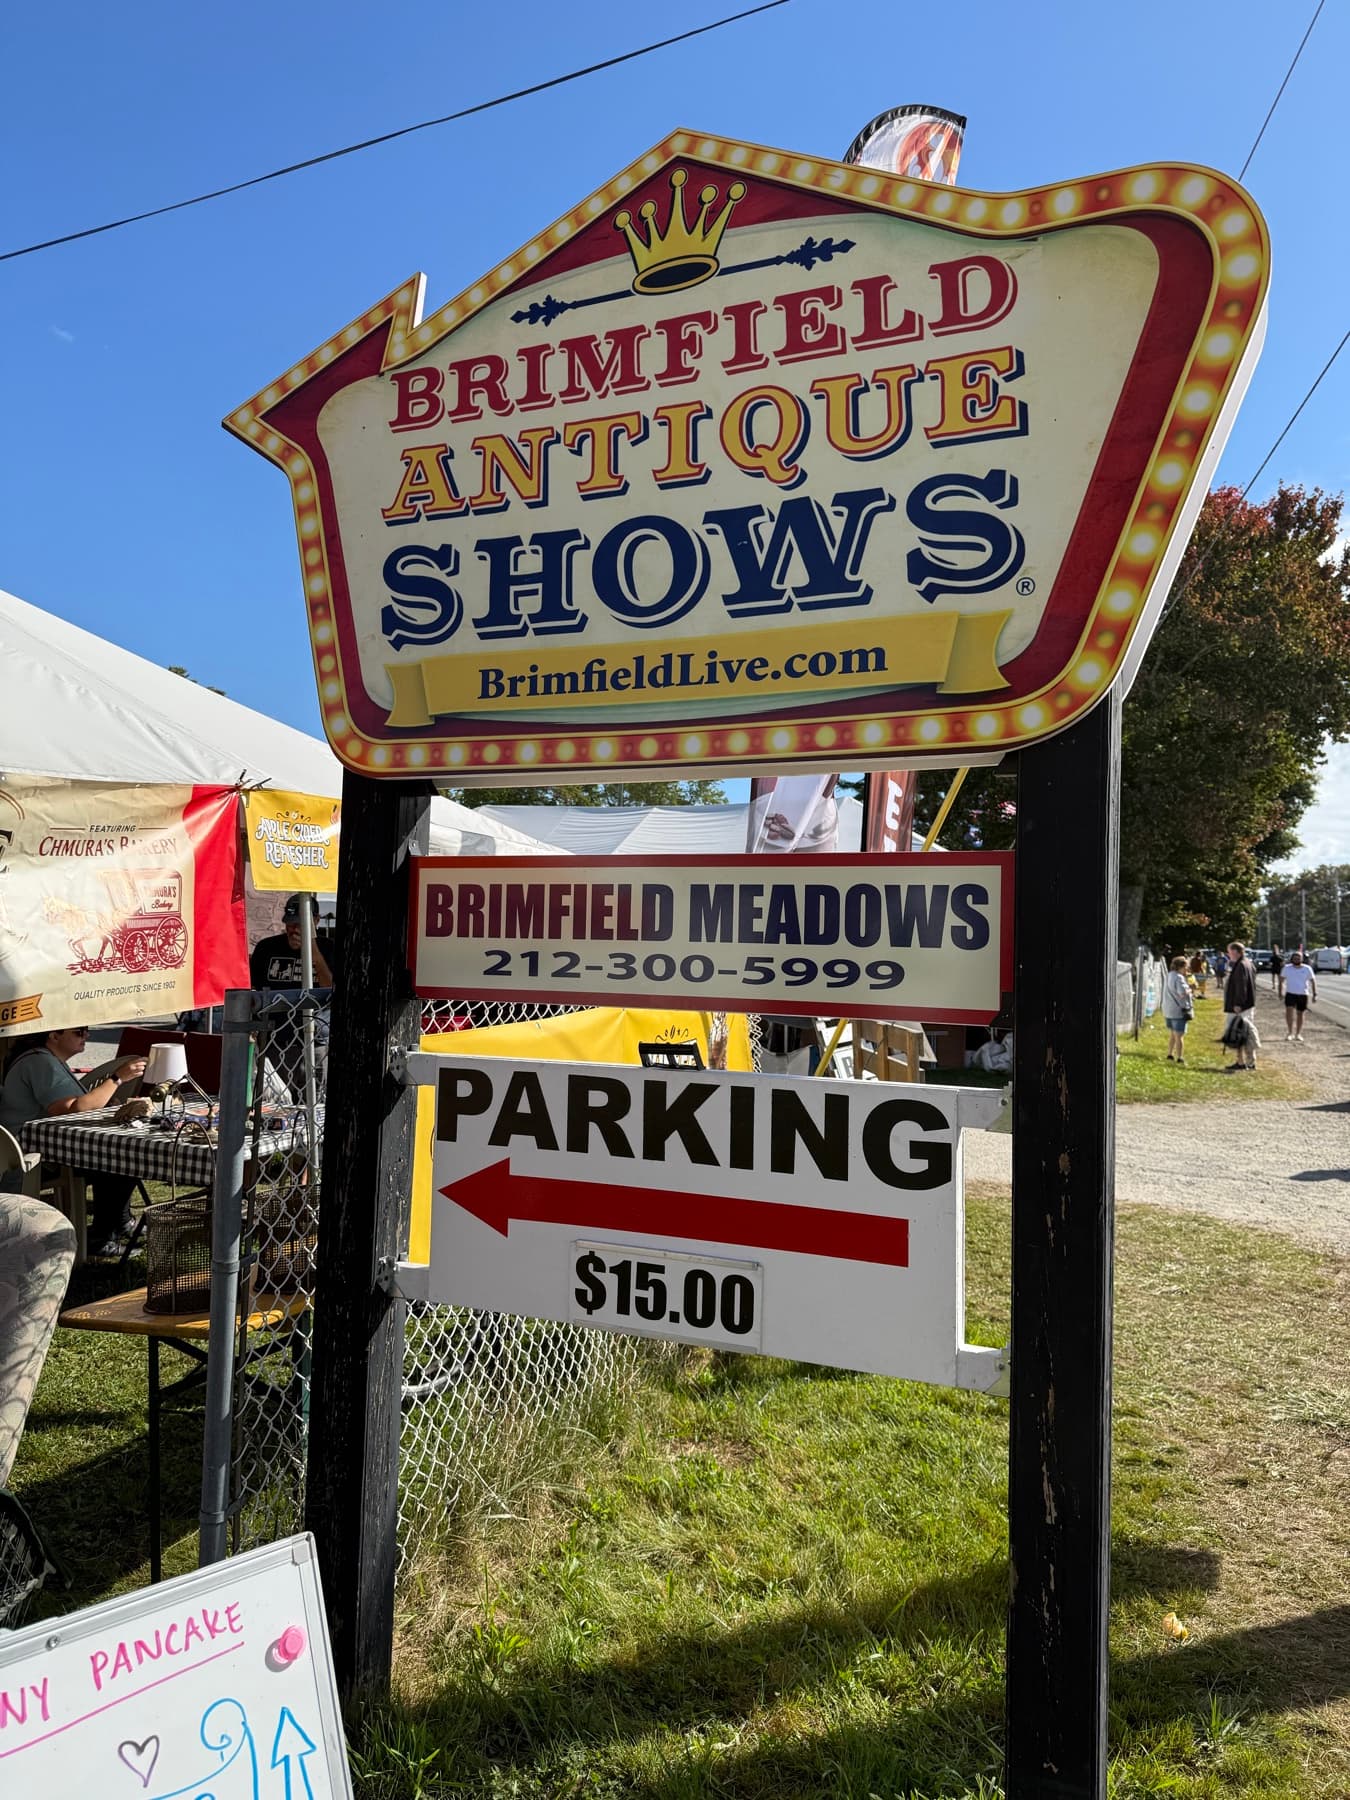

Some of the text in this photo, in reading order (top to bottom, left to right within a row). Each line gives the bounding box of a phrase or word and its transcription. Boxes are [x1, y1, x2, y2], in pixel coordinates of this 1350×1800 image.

[388, 254, 1018, 432] BRIMFIELD
[381, 345, 1028, 526] ANTIQUE
[381, 469, 1024, 651] SHOWS
[478, 644, 888, 699] BrimfieldLive.com
[39, 836, 177, 857] CHMURA'S BKERY
[89, 825, 136, 833] FEATURING
[144, 886, 177, 898] MURA'S
[425, 883, 990, 950] BRIMFIELD MEADOWS
[74, 988, 105, 1001] QUALITY
[106, 984, 141, 997] PRODUCTS
[142, 982, 162, 992] SINCE
[483, 949, 906, 990] 212-300-5999
[437, 1067, 953, 1191] PARKING
[574, 1251, 755, 1336] $15.00
[90, 1602, 244, 1691] PANCAKE
